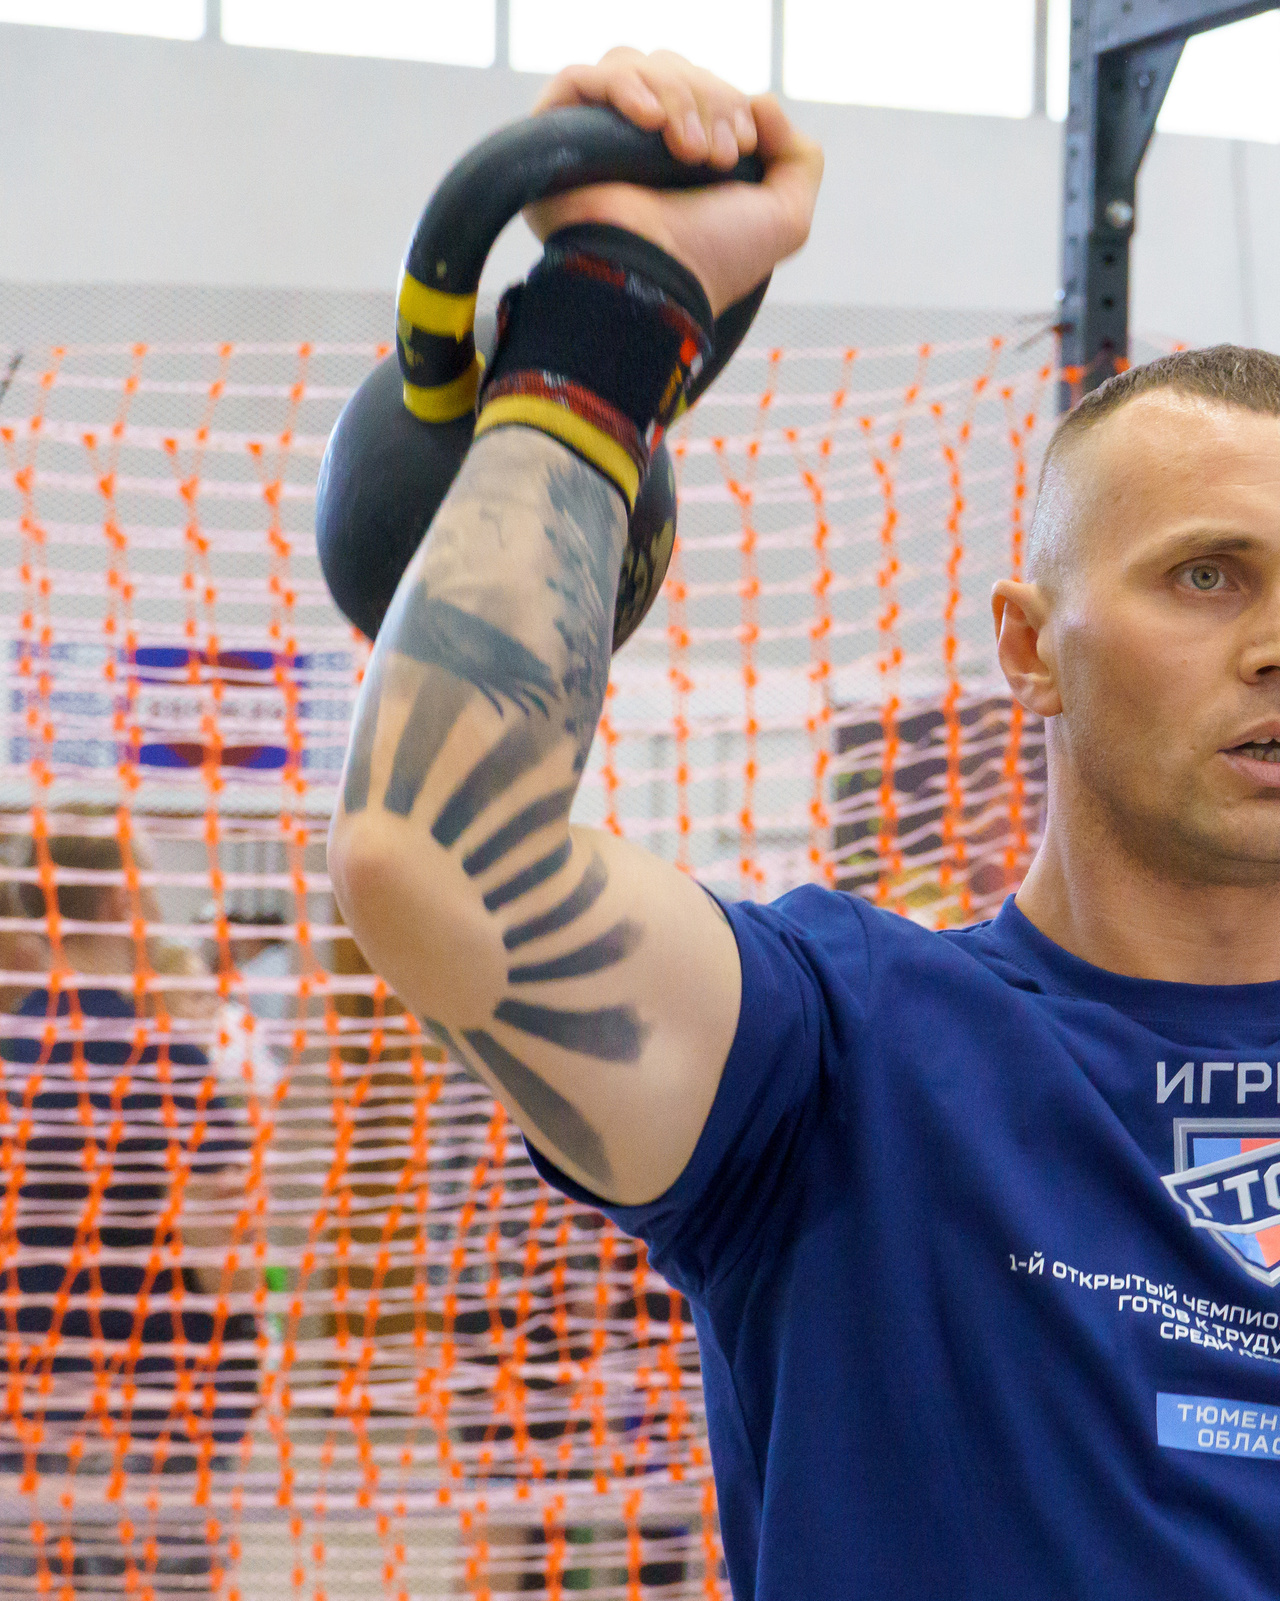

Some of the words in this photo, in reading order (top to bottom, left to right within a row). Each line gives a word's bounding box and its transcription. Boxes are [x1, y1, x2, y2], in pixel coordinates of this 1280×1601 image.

[1009, 1251, 1045, 1275] 1-Й
[1052, 1261, 1177, 1304] ОТКРЫТЫЙ
[1118, 1295, 1190, 1324] ГОТОВ
[1195, 1316, 1209, 1332] К
[1160, 1322, 1233, 1352] СРЕДИ
